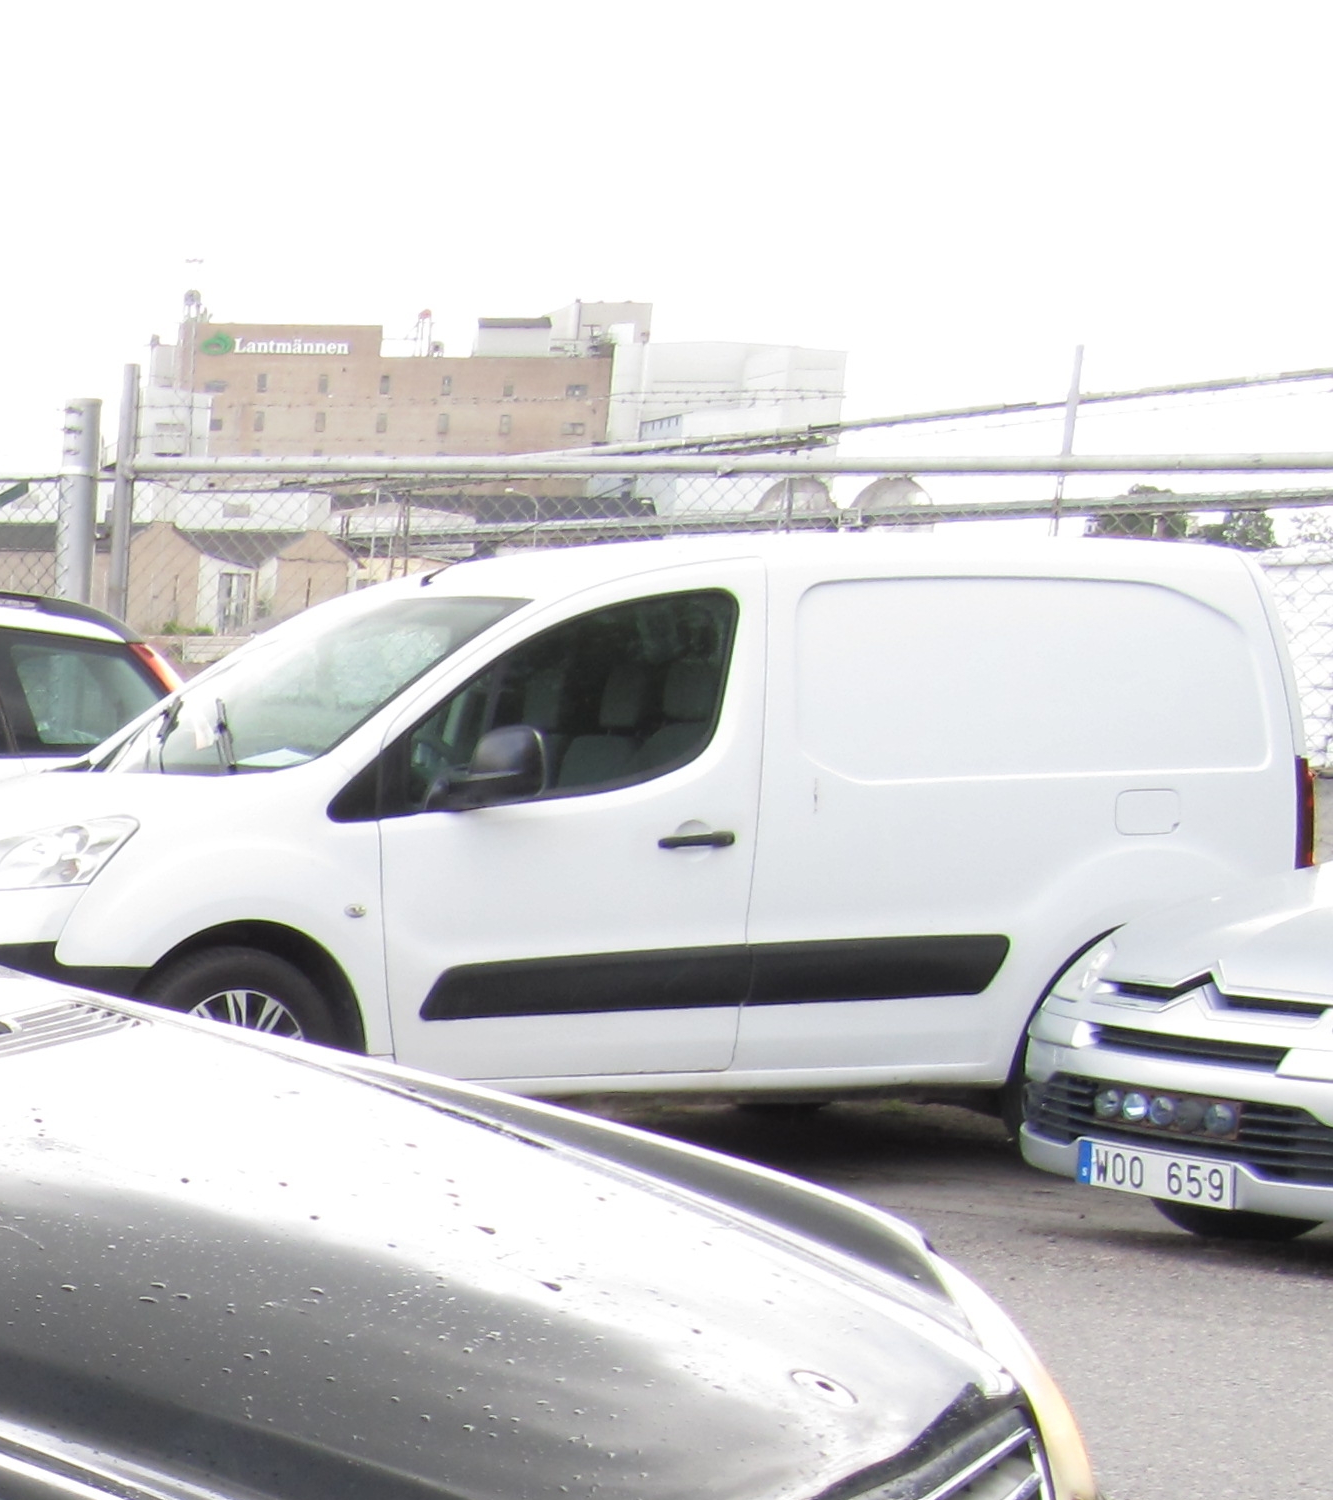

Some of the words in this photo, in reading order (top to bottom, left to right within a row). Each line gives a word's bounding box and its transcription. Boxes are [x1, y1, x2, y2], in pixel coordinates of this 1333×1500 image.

[234, 337, 349, 355] Lantmännen
[1096, 1149, 1144, 1189] WOO
[1167, 1162, 1224, 1201] 659
